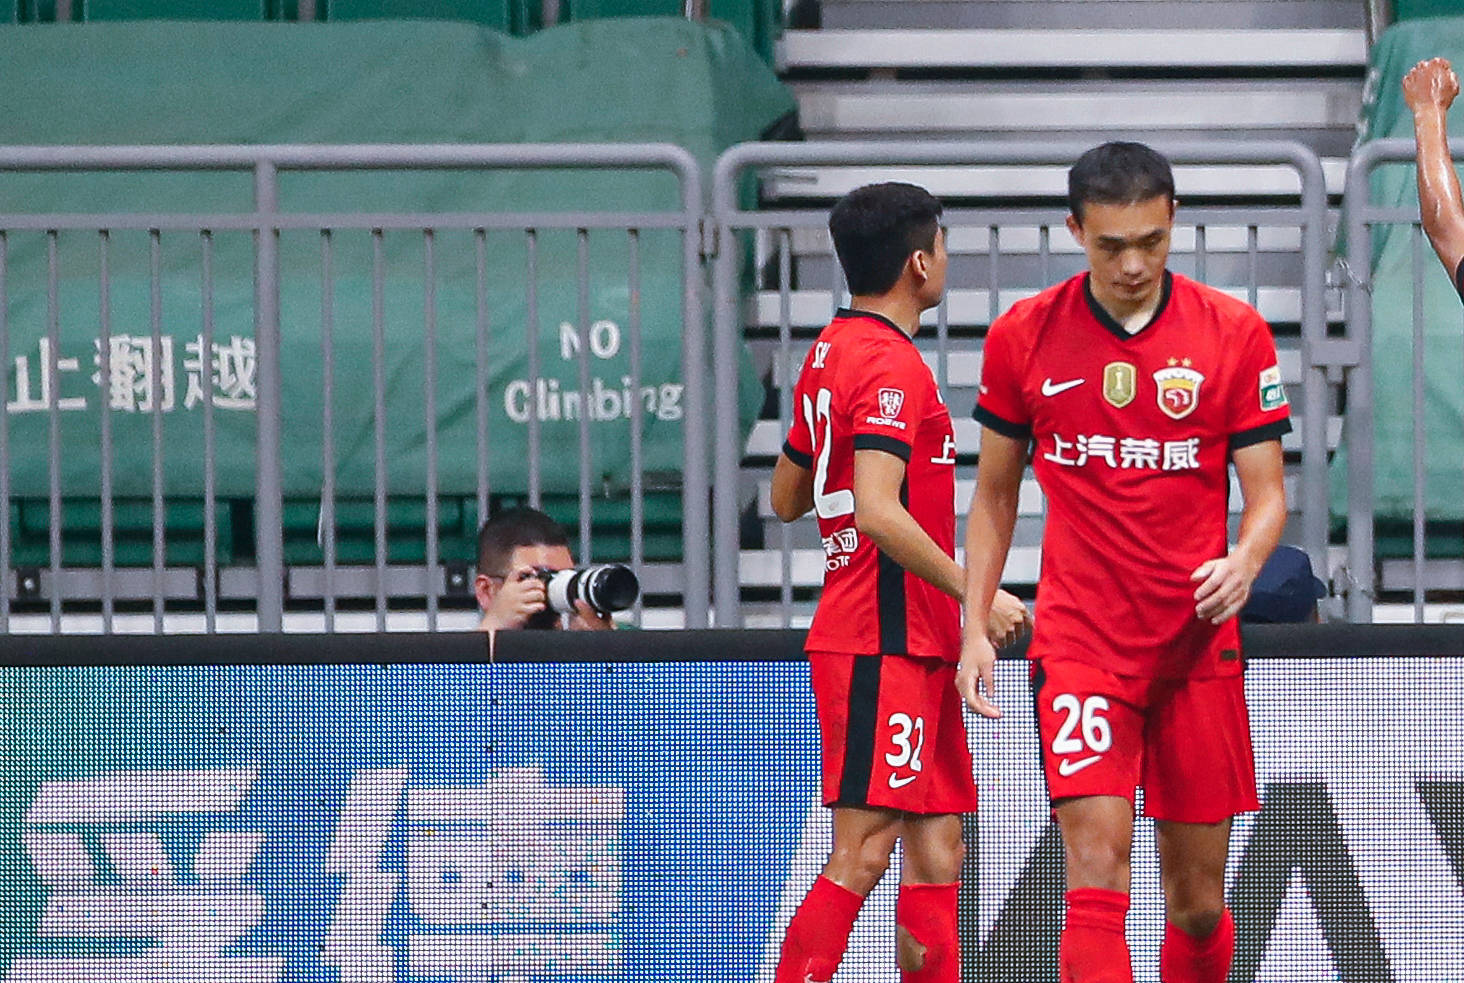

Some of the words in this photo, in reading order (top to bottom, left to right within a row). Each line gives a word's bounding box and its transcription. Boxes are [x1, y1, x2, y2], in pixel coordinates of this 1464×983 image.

[504, 376, 684, 423] Climbing
[1043, 433, 1201, 471] 上汽荣威
[1051, 693, 1112, 755] 26
